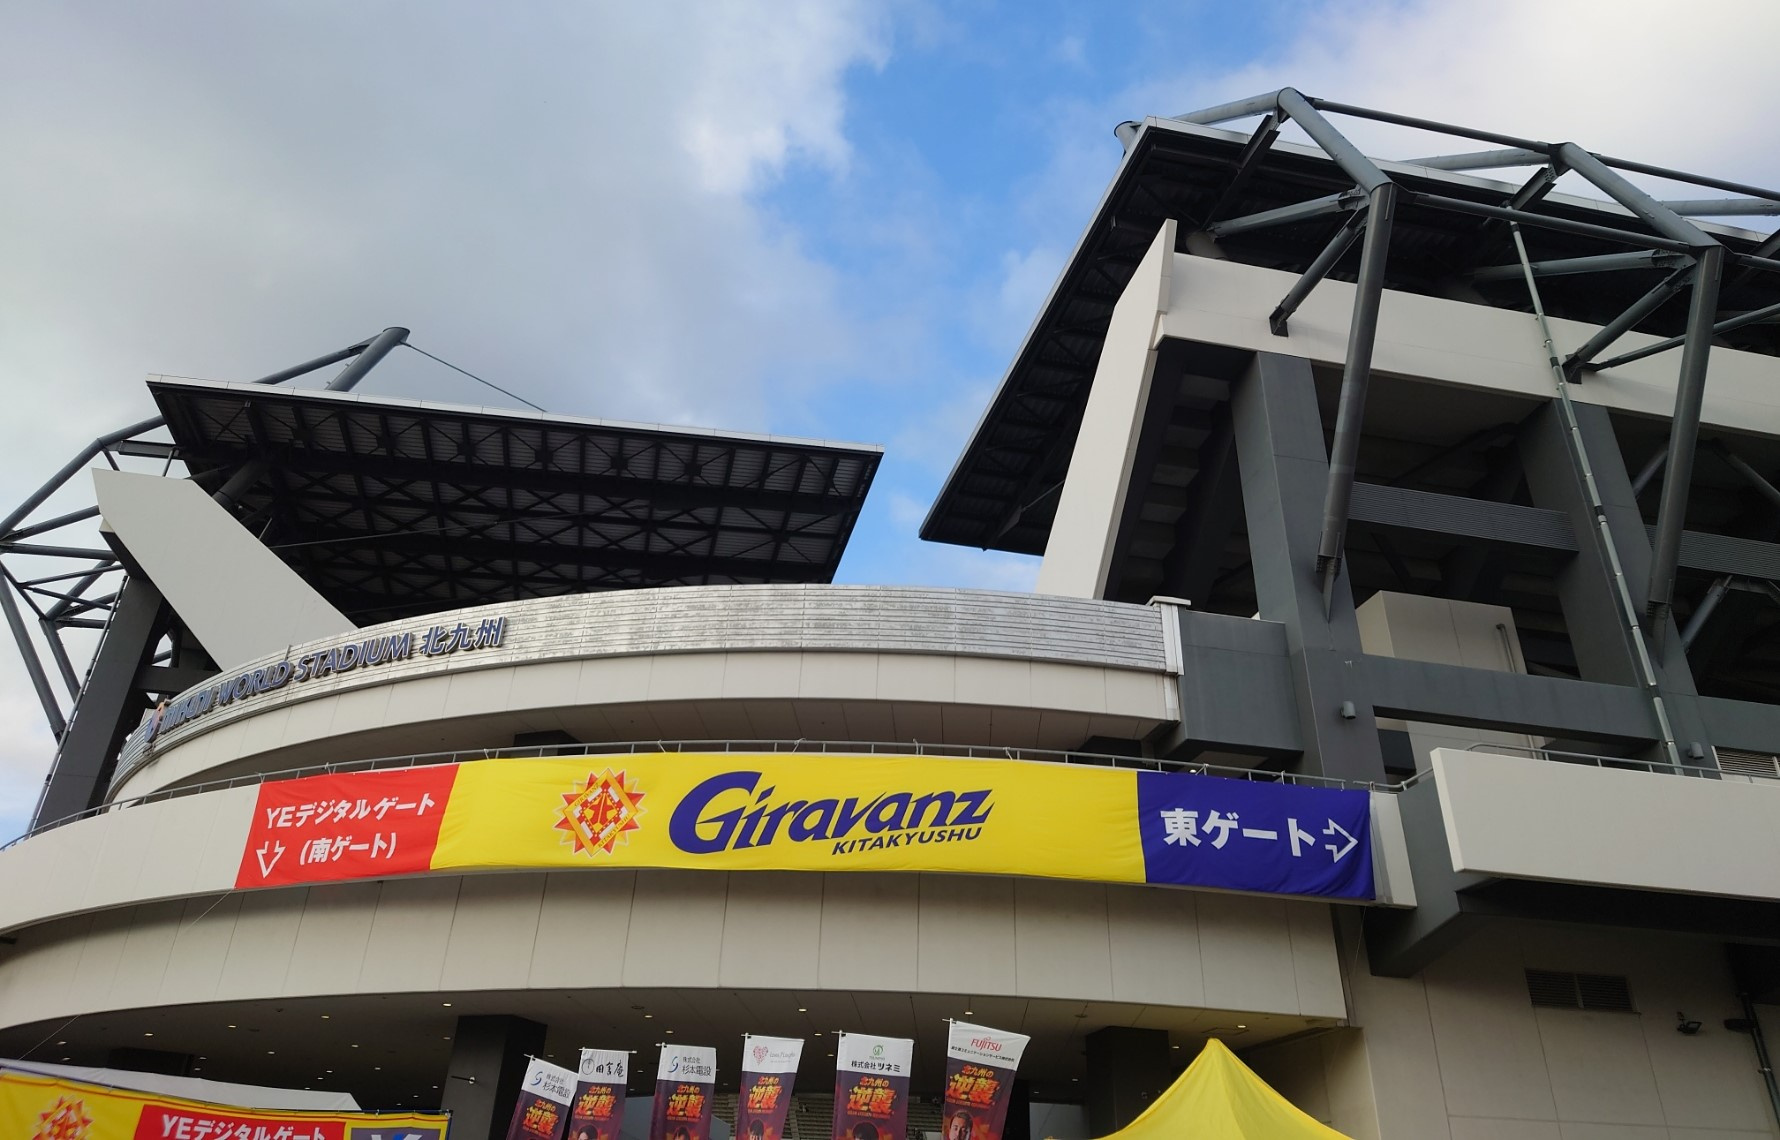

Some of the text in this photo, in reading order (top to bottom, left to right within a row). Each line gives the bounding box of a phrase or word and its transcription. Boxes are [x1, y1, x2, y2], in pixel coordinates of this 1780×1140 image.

[218, 661, 295, 707] WORLD
[293, 631, 413, 683] STADIUM
[419, 616, 508, 657] 北九州
[265, 791, 436, 830] YEデジタルゲート
[668, 770, 995, 855] Giravanz
[1160, 806, 1317, 857] 東ゲート
[831, 826, 983, 856] KITAKYUSHU
[299, 833, 398, 866] (南ゲート)
[970, 1036, 1002, 1052] FUJITSU
[877, 1062, 901, 1073] ツネミ
[961, 1064, 994, 1078] 北九州の
[758, 1076, 780, 1085] 北九州の
[859, 1076, 890, 1088] 北九州の
[588, 1085, 612, 1095] 北九州の
[677, 1084, 701, 1094] 北九州の
[534, 1099, 557, 1112] 北九州の
